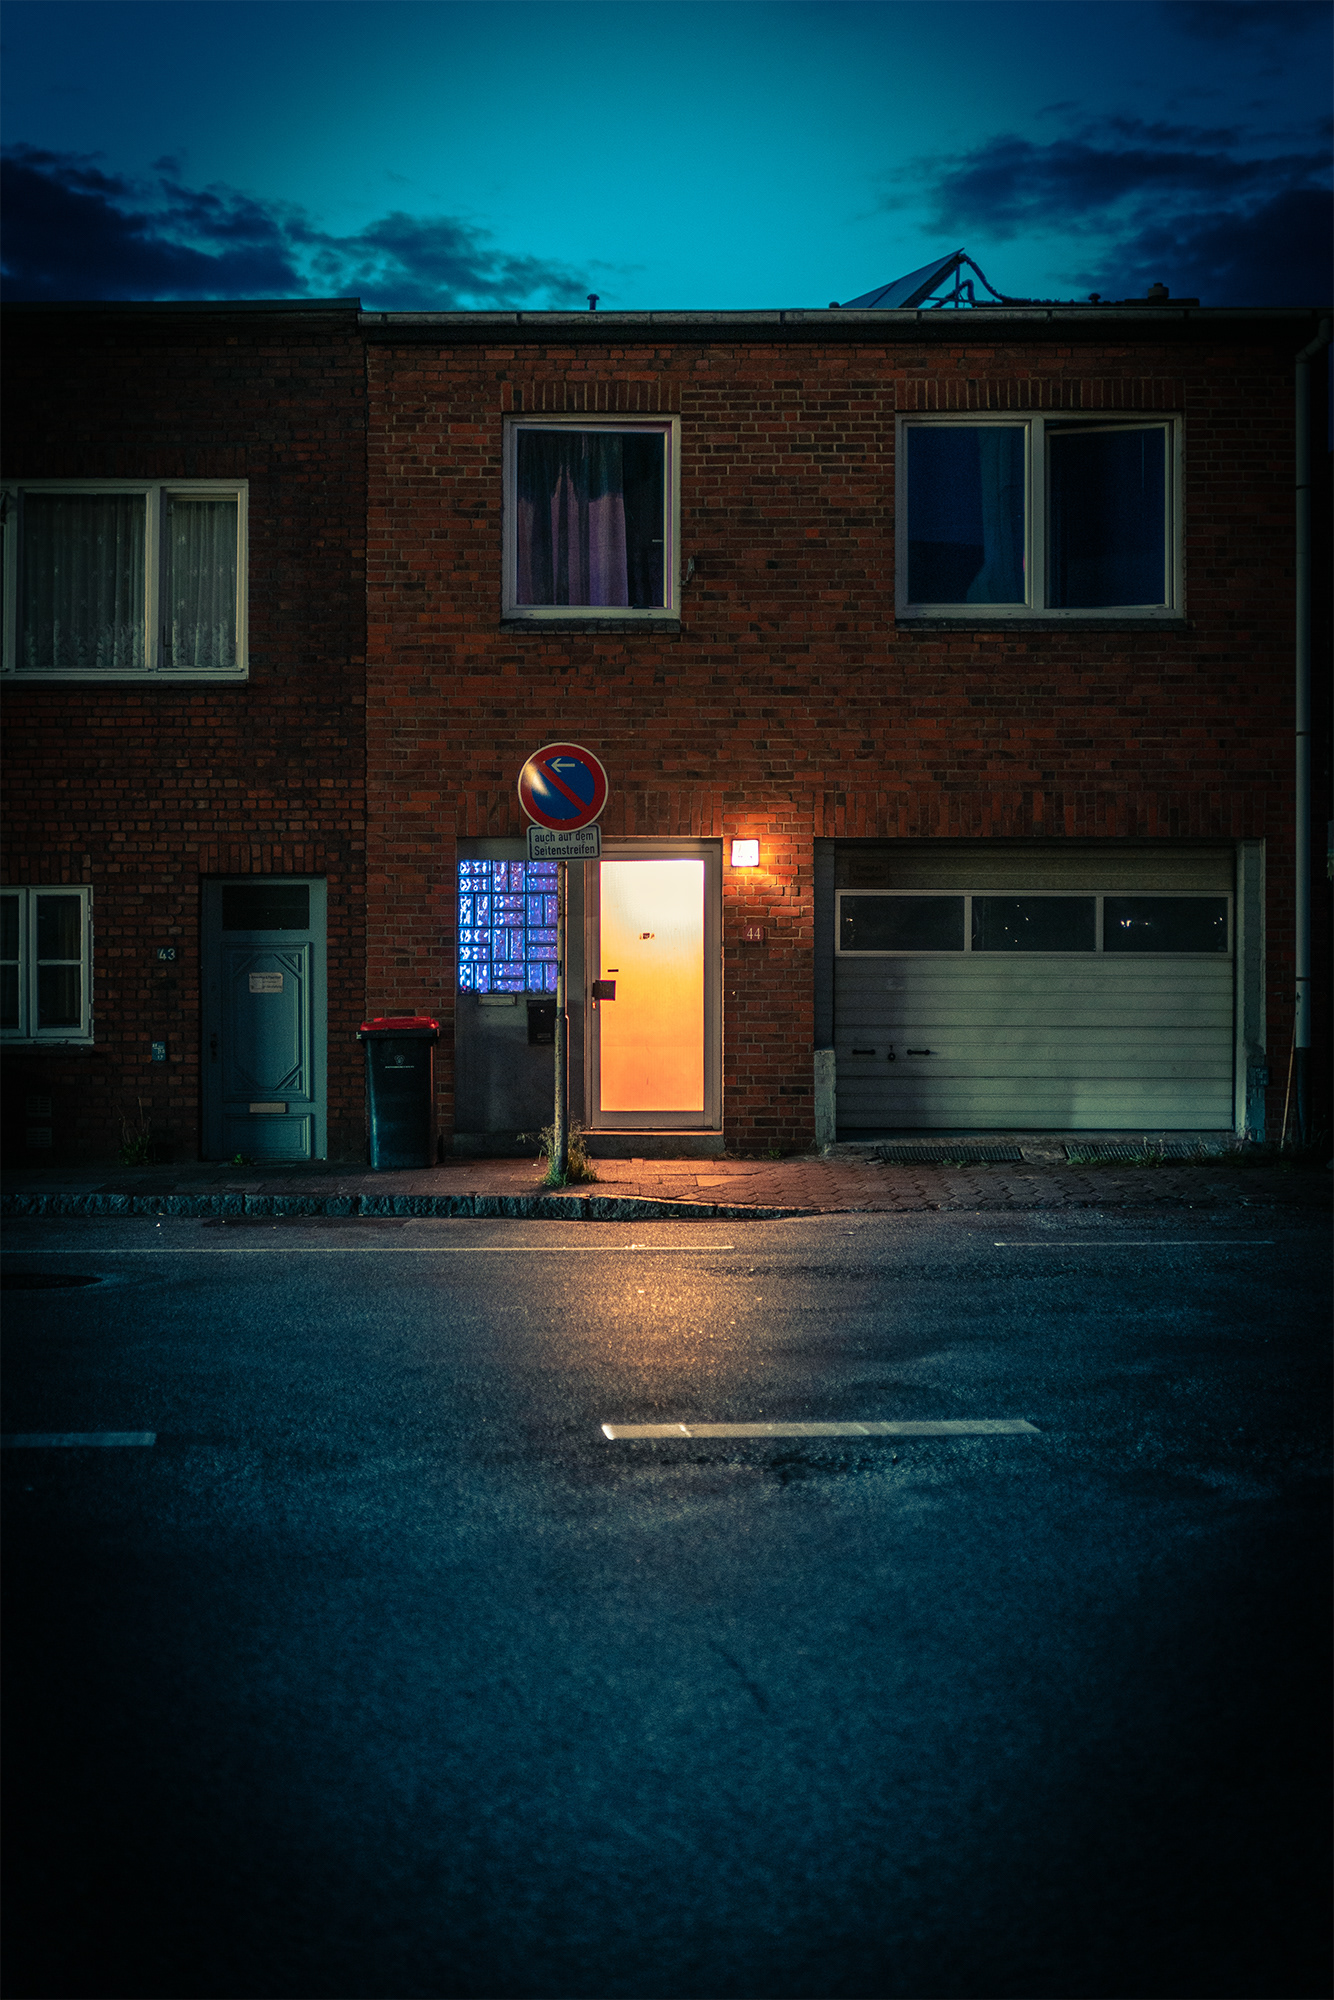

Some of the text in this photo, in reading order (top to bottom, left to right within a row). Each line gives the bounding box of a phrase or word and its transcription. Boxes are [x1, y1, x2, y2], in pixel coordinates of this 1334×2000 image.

[534, 831, 594, 842] auch auf dem
[534, 844, 595, 856] Seitenstreifen
[747, 927, 761, 940] 44
[159, 947, 175, 960] 43
